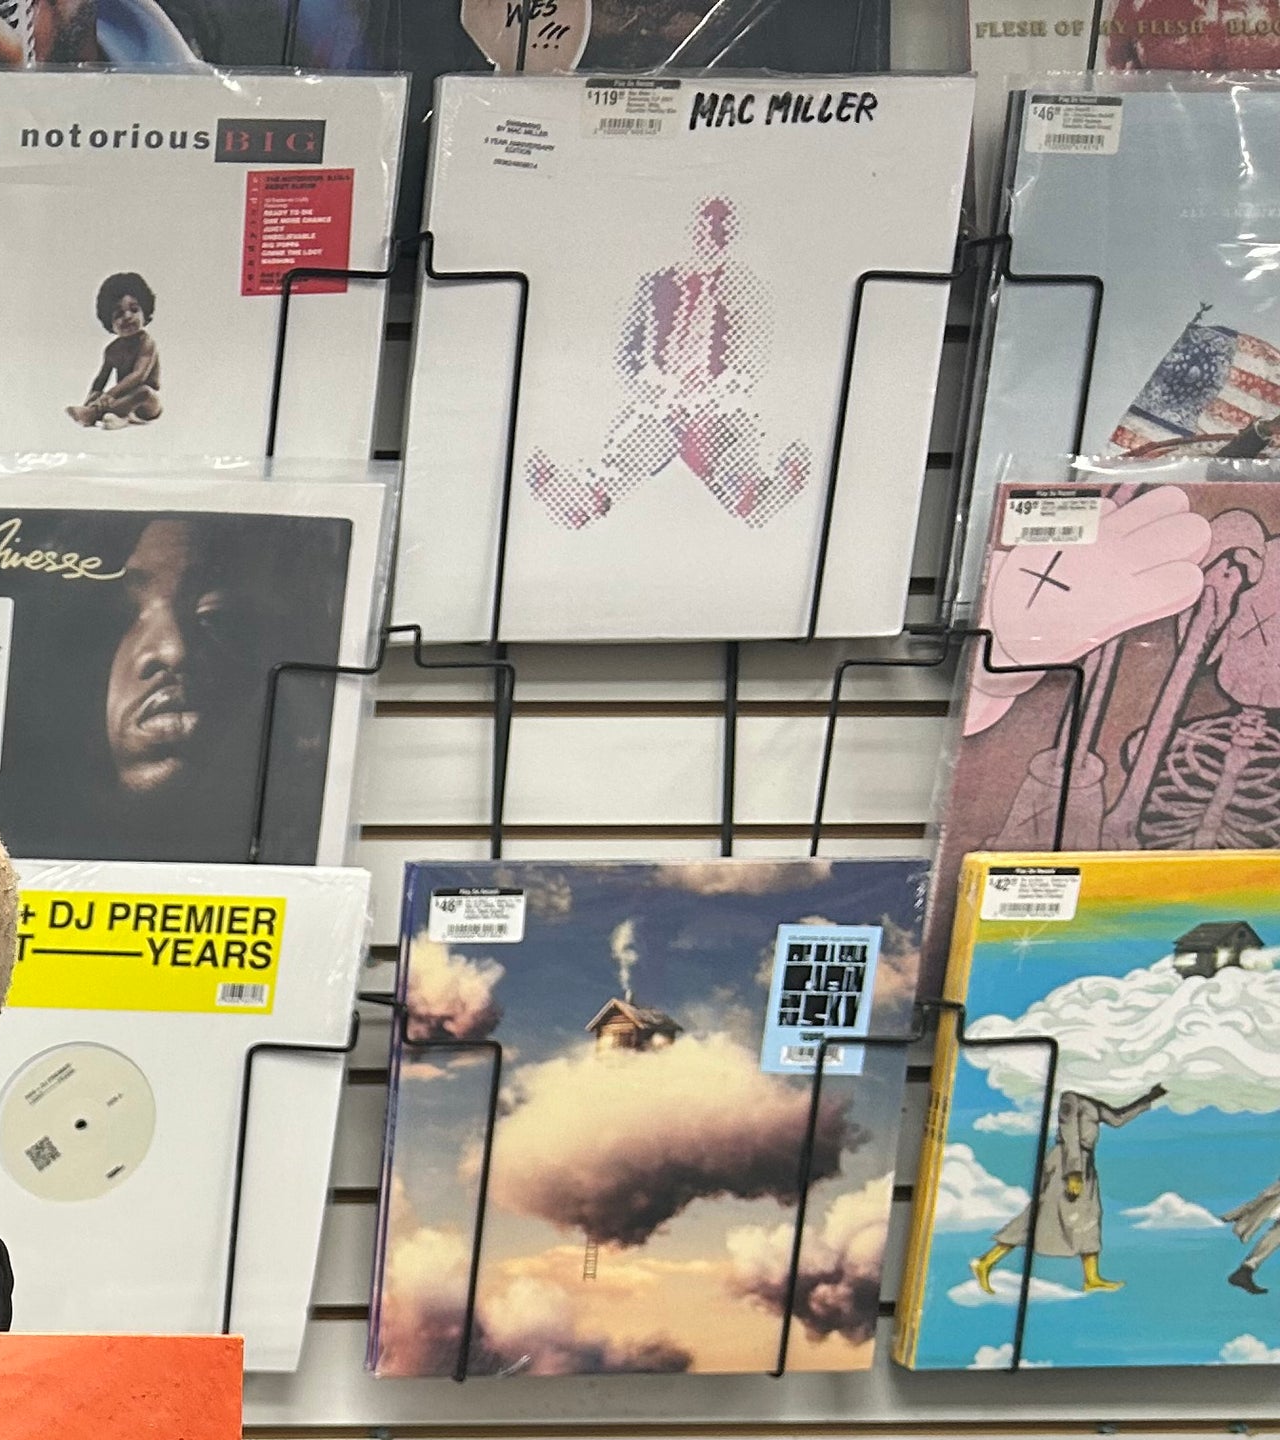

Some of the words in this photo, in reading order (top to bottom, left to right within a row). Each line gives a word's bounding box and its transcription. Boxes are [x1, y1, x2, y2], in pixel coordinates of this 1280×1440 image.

[975, 20, 1047, 39] FLESH
[1055, 20, 1084, 37] OF
[1140, 19, 1207, 36] FLESH
[588, 90, 618, 107] $119
[689, 92, 756, 130] MAC
[765, 91, 879, 125] MILLER
[1033, 105, 1053, 121] $46
[21, 124, 210, 149] notorious
[48, 900, 95, 930] DJ
[108, 901, 278, 936] PREMIER
